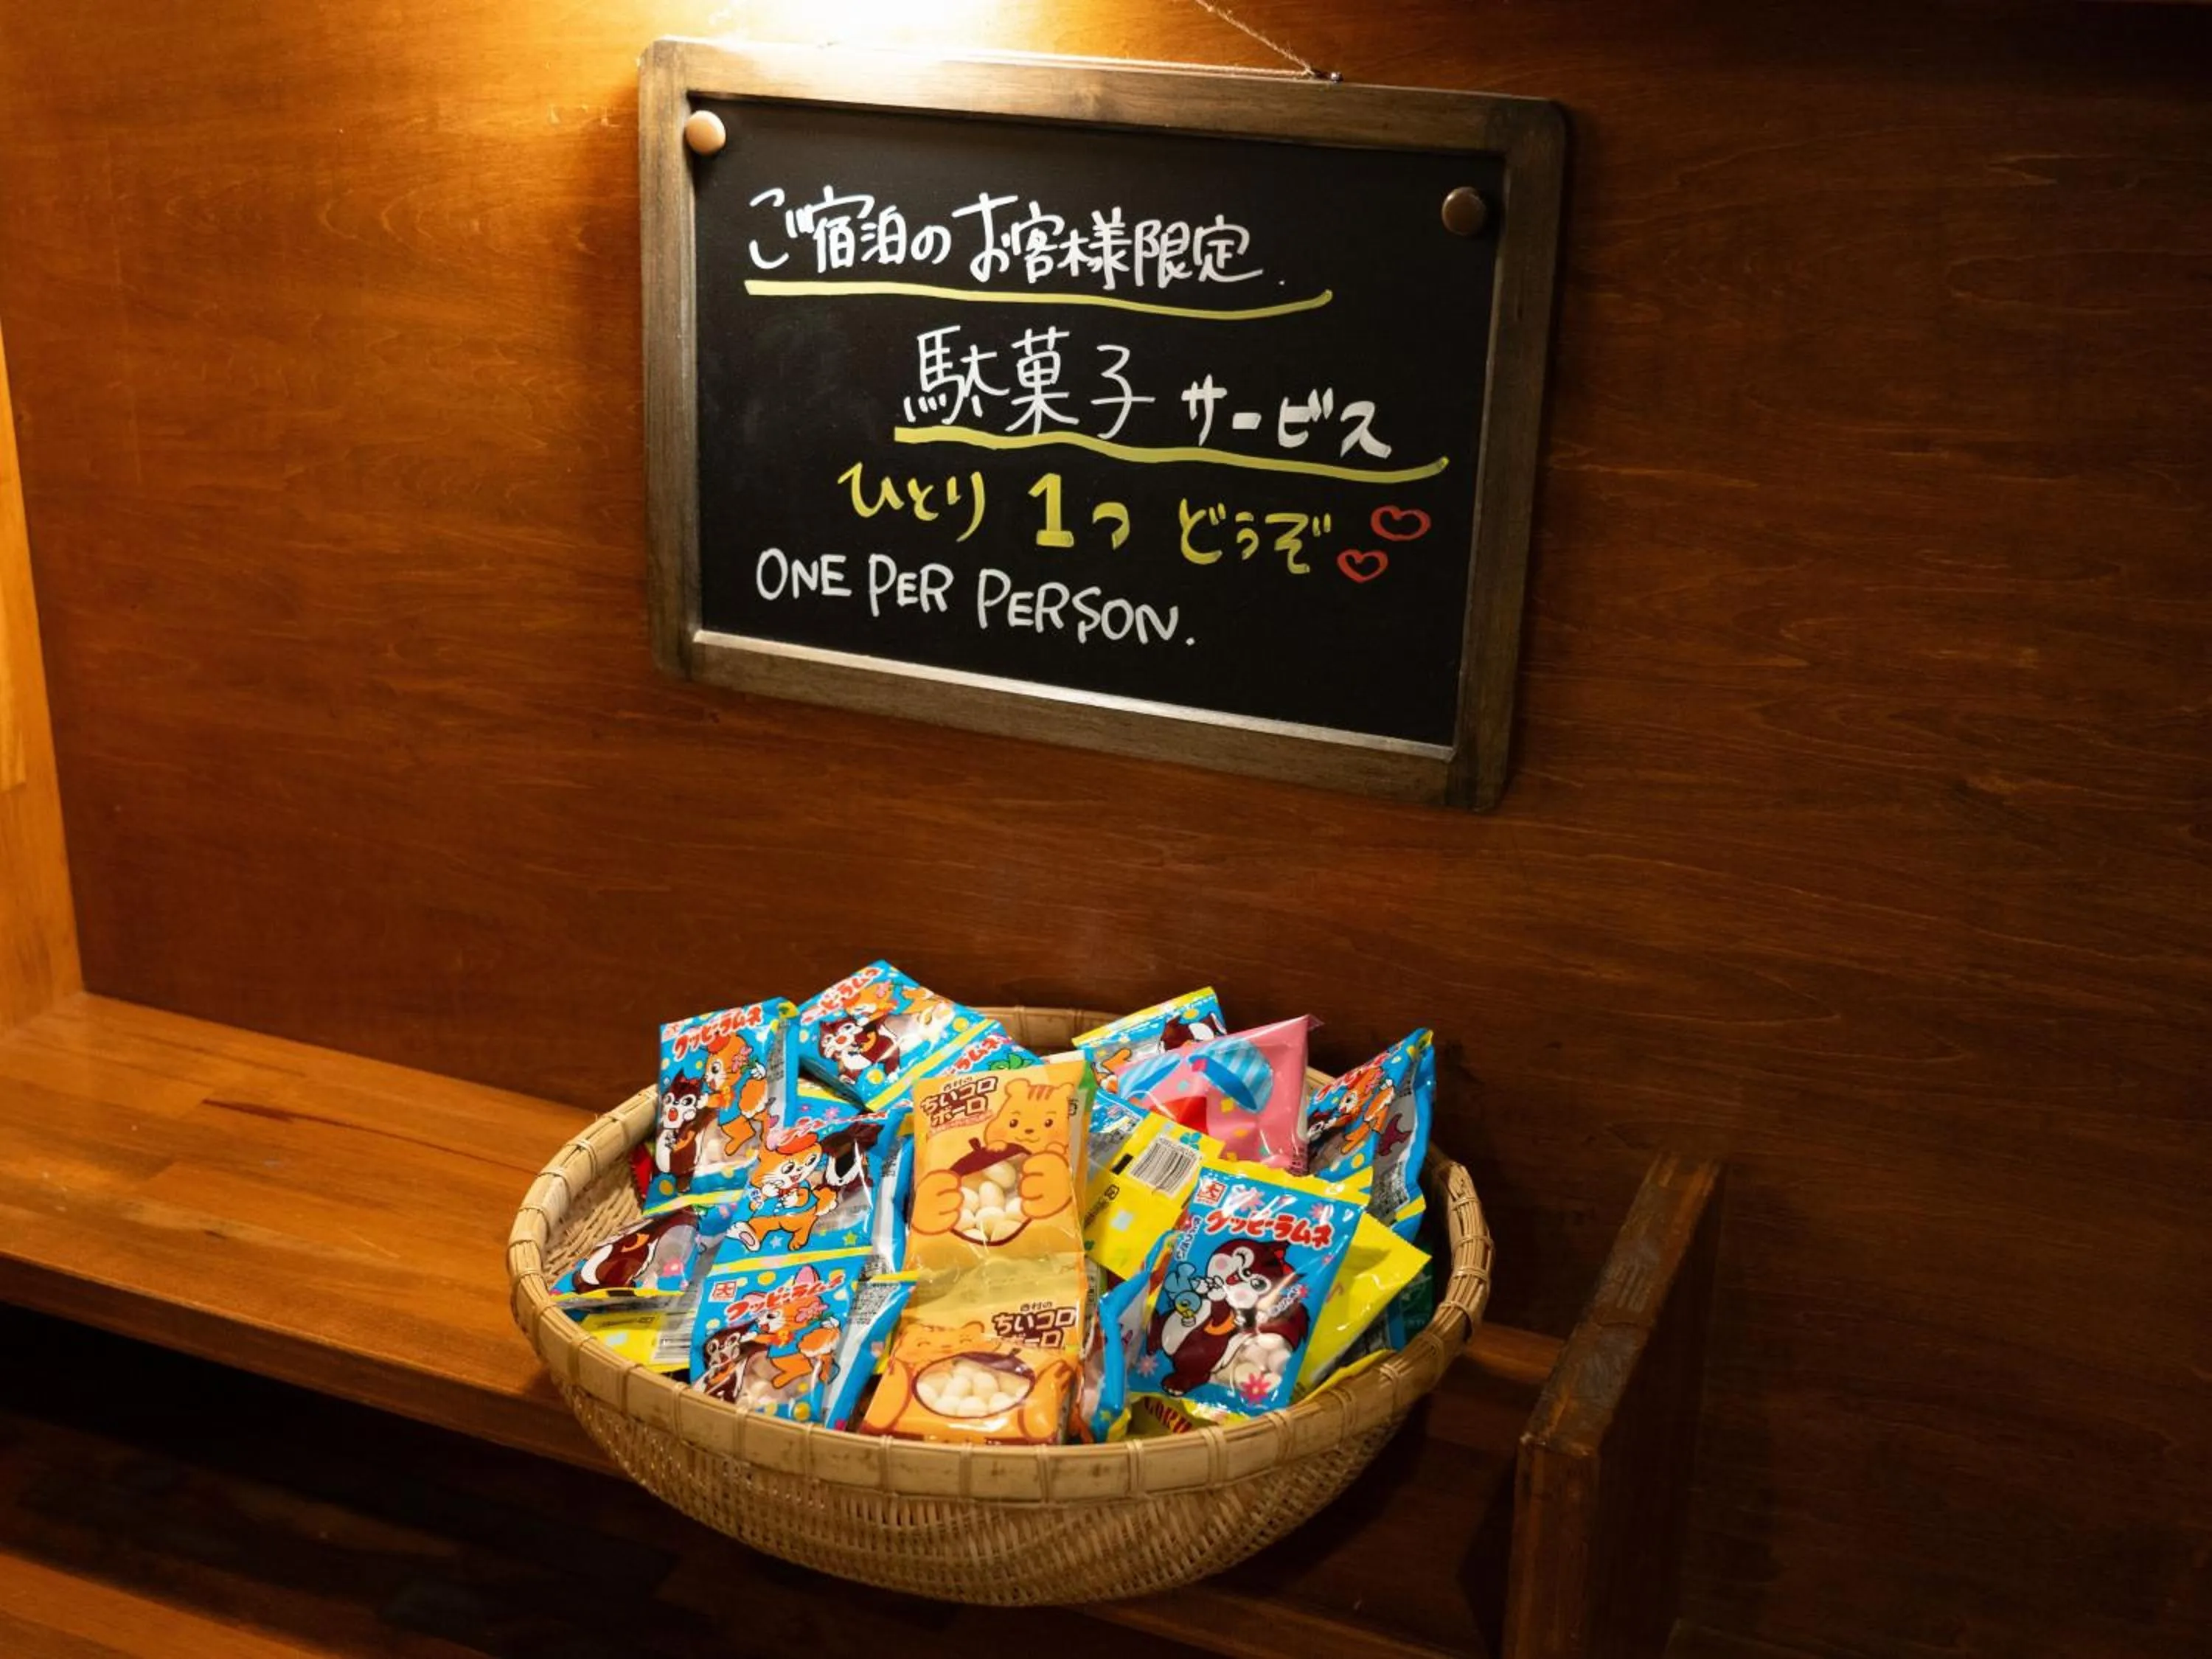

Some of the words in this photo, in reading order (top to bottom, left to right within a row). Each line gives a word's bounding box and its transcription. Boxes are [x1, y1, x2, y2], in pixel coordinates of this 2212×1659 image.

[903, 324, 1156, 441] 駄菓子
[1181, 373, 1392, 459] サービス
[838, 461, 986, 542] ひとり
[1027, 472, 1130, 549] 1つ
[1179, 498, 1331, 574] どうぞ
[756, 548, 852, 600] ONE
[868, 553, 954, 617] PER
[977, 567, 1196, 646] PERSON.
[950, 1034, 1001, 1074] ラムネ
[920, 1077, 998, 1115] ちいコロ
[931, 1095, 989, 1127] ボーロ
[1205, 1210, 1333, 1250] クッピーラムネ
[992, 1305, 1077, 1338] ちいコロ
